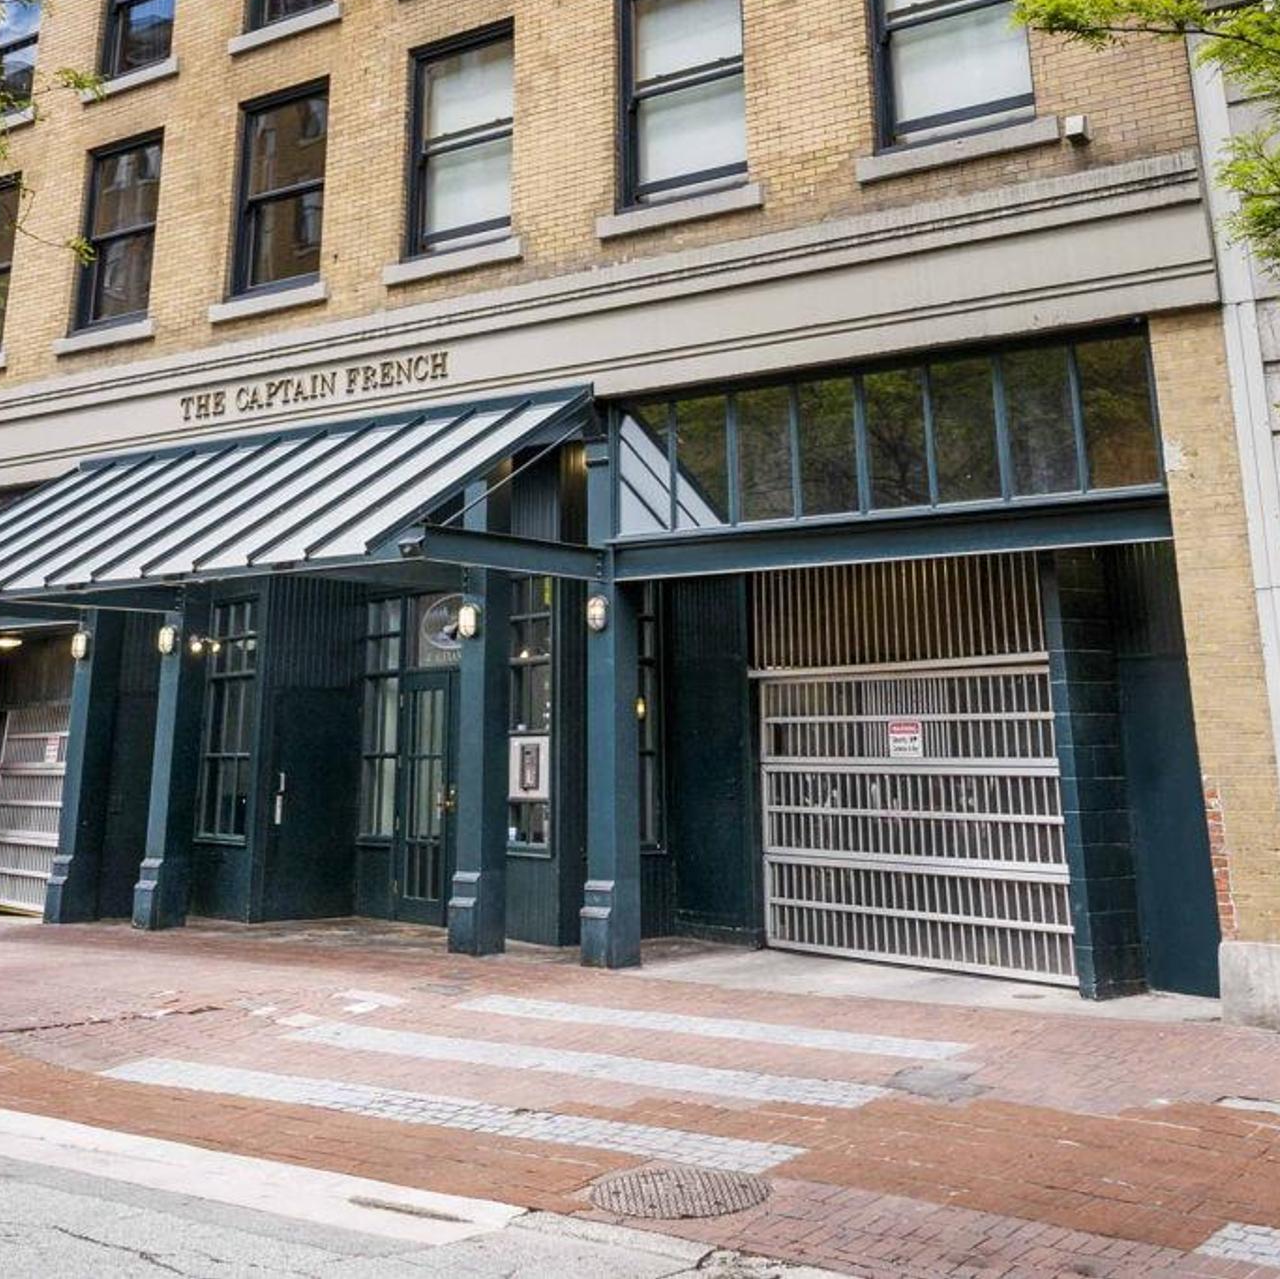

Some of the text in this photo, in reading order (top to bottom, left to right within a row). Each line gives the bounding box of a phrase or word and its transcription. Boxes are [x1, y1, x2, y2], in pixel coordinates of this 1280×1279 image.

[180, 351, 449, 421] THE CAPTAIN FRENCH
